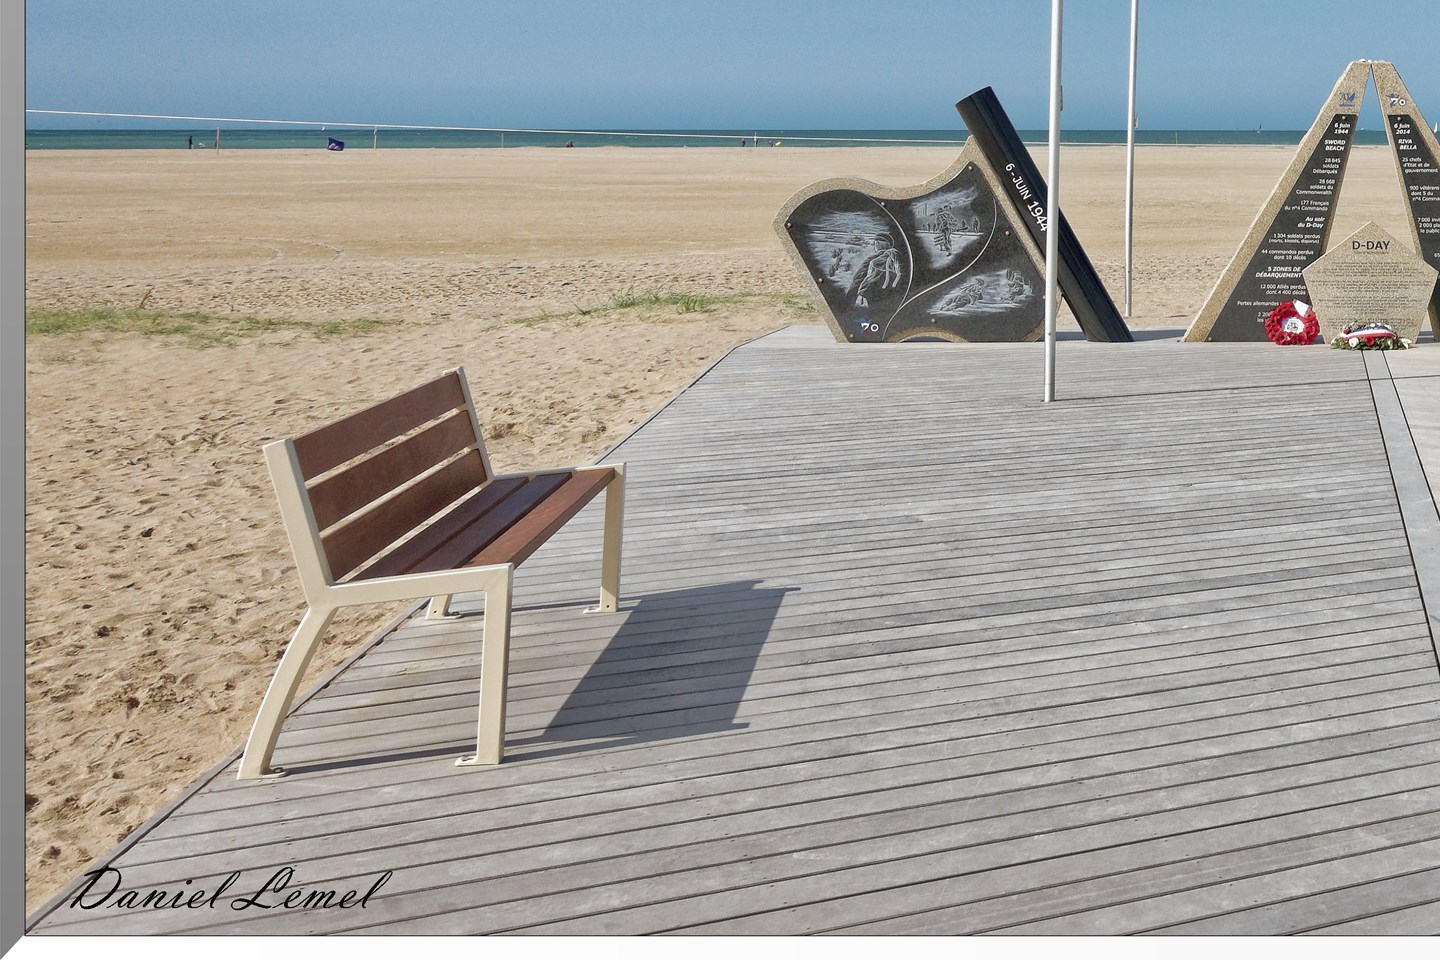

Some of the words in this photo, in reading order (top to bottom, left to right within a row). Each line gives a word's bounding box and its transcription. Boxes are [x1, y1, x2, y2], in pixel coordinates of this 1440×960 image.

[1390, 98, 1406, 106] 70
[1027, 201, 1048, 232] 1944
[1352, 241, 1390, 250] D-DAY
[861, 322, 879, 332] 70
